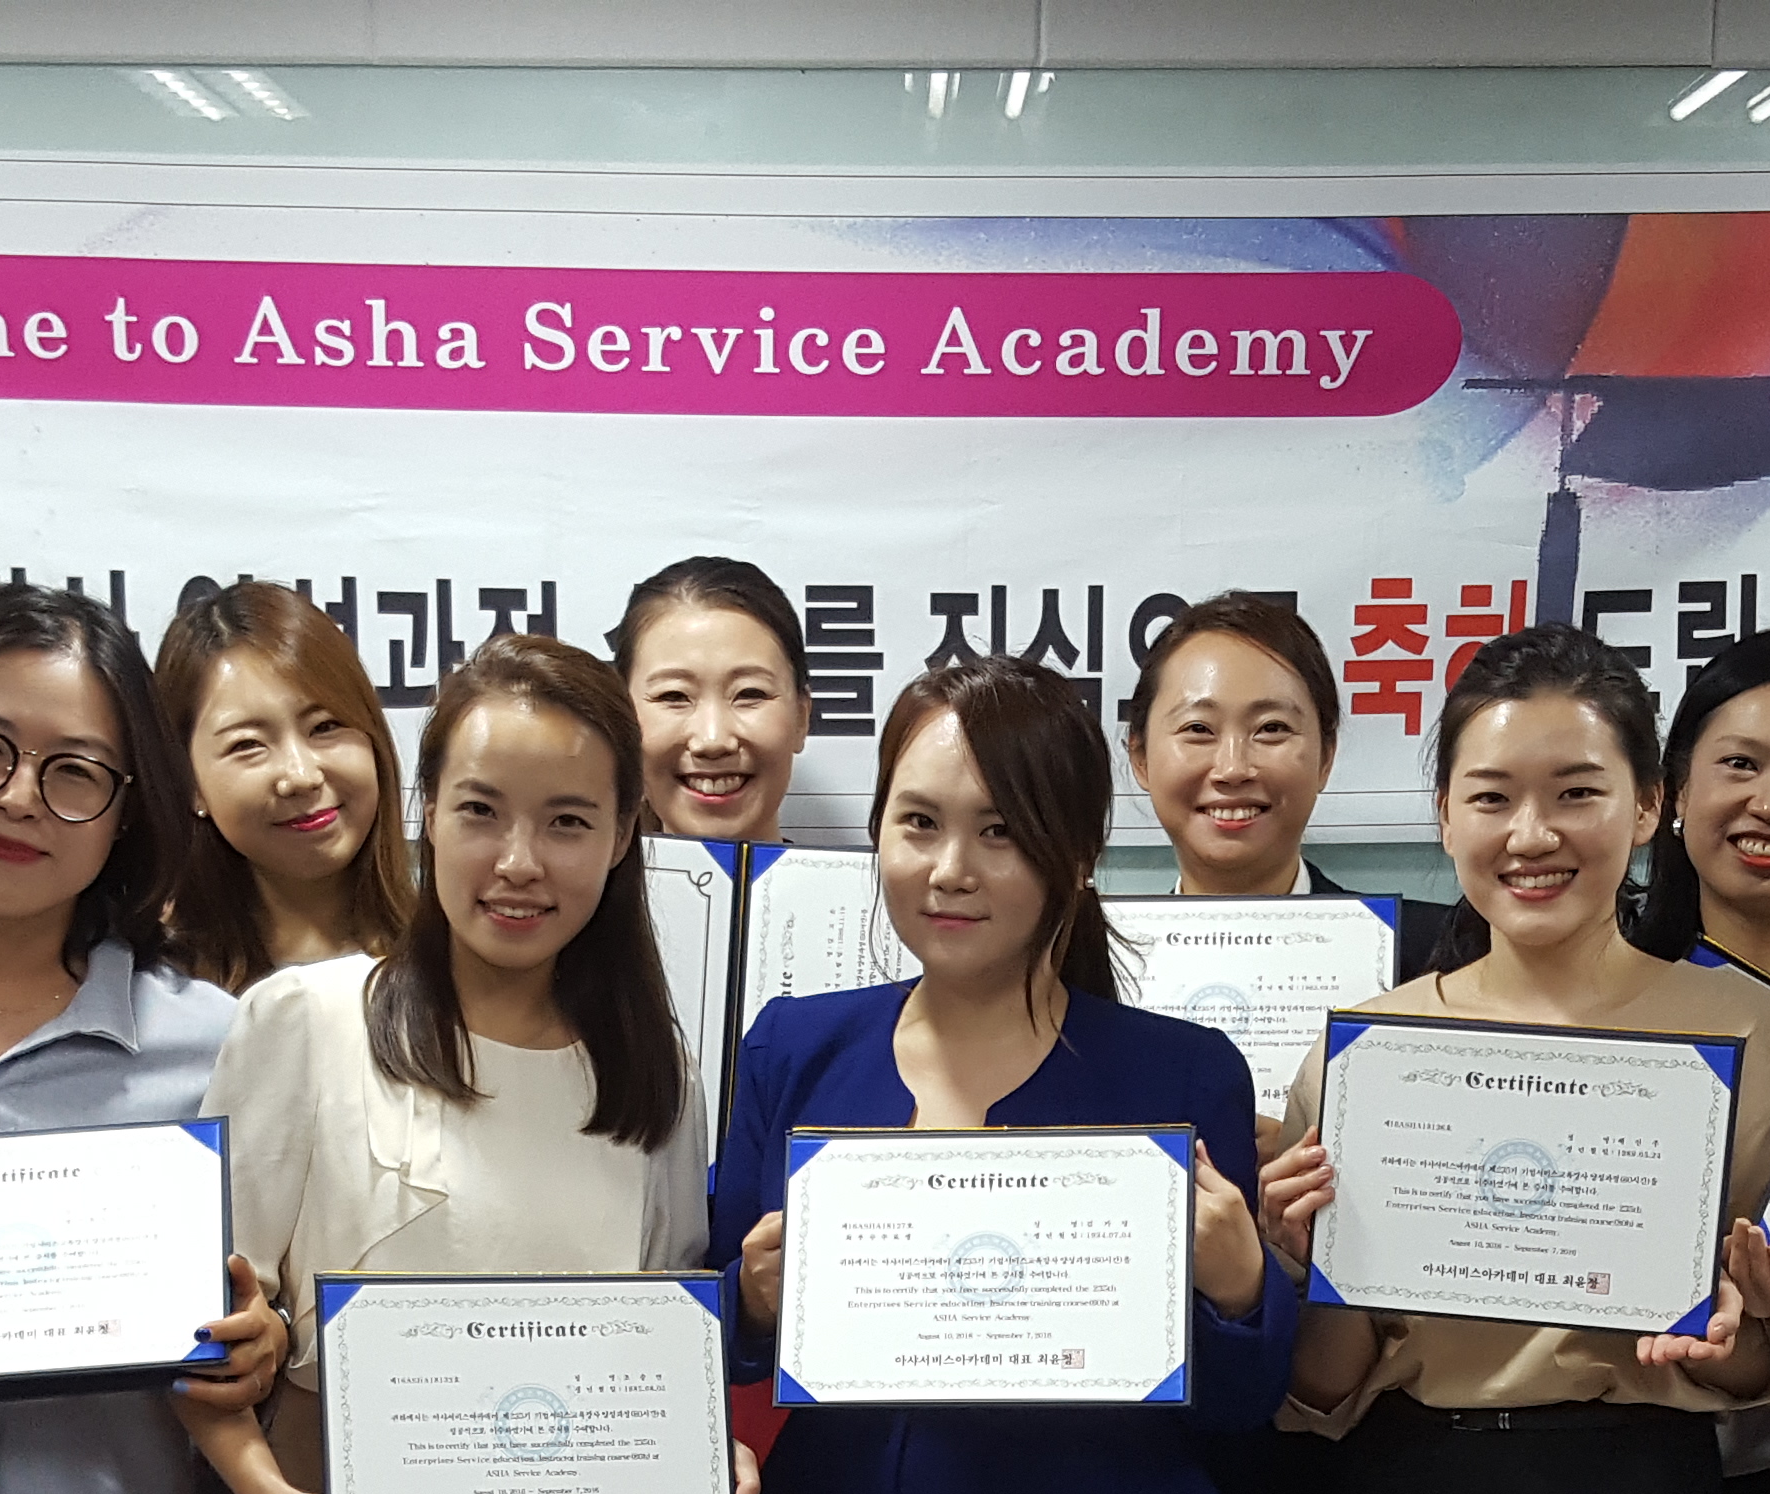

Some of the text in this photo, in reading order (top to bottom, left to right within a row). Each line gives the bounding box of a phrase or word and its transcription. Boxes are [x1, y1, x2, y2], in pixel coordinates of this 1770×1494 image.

[103, 298, 203, 368] to
[235, 288, 487, 372] Asha
[519, 298, 889, 378] Service
[919, 305, 1376, 390] Academy
[1166, 932, 1273, 950] Certificate
[1465, 1070, 1589, 1097] Certificate
[927, 1172, 1050, 1192] Certificate
[467, 1320, 588, 1342] Certificate
